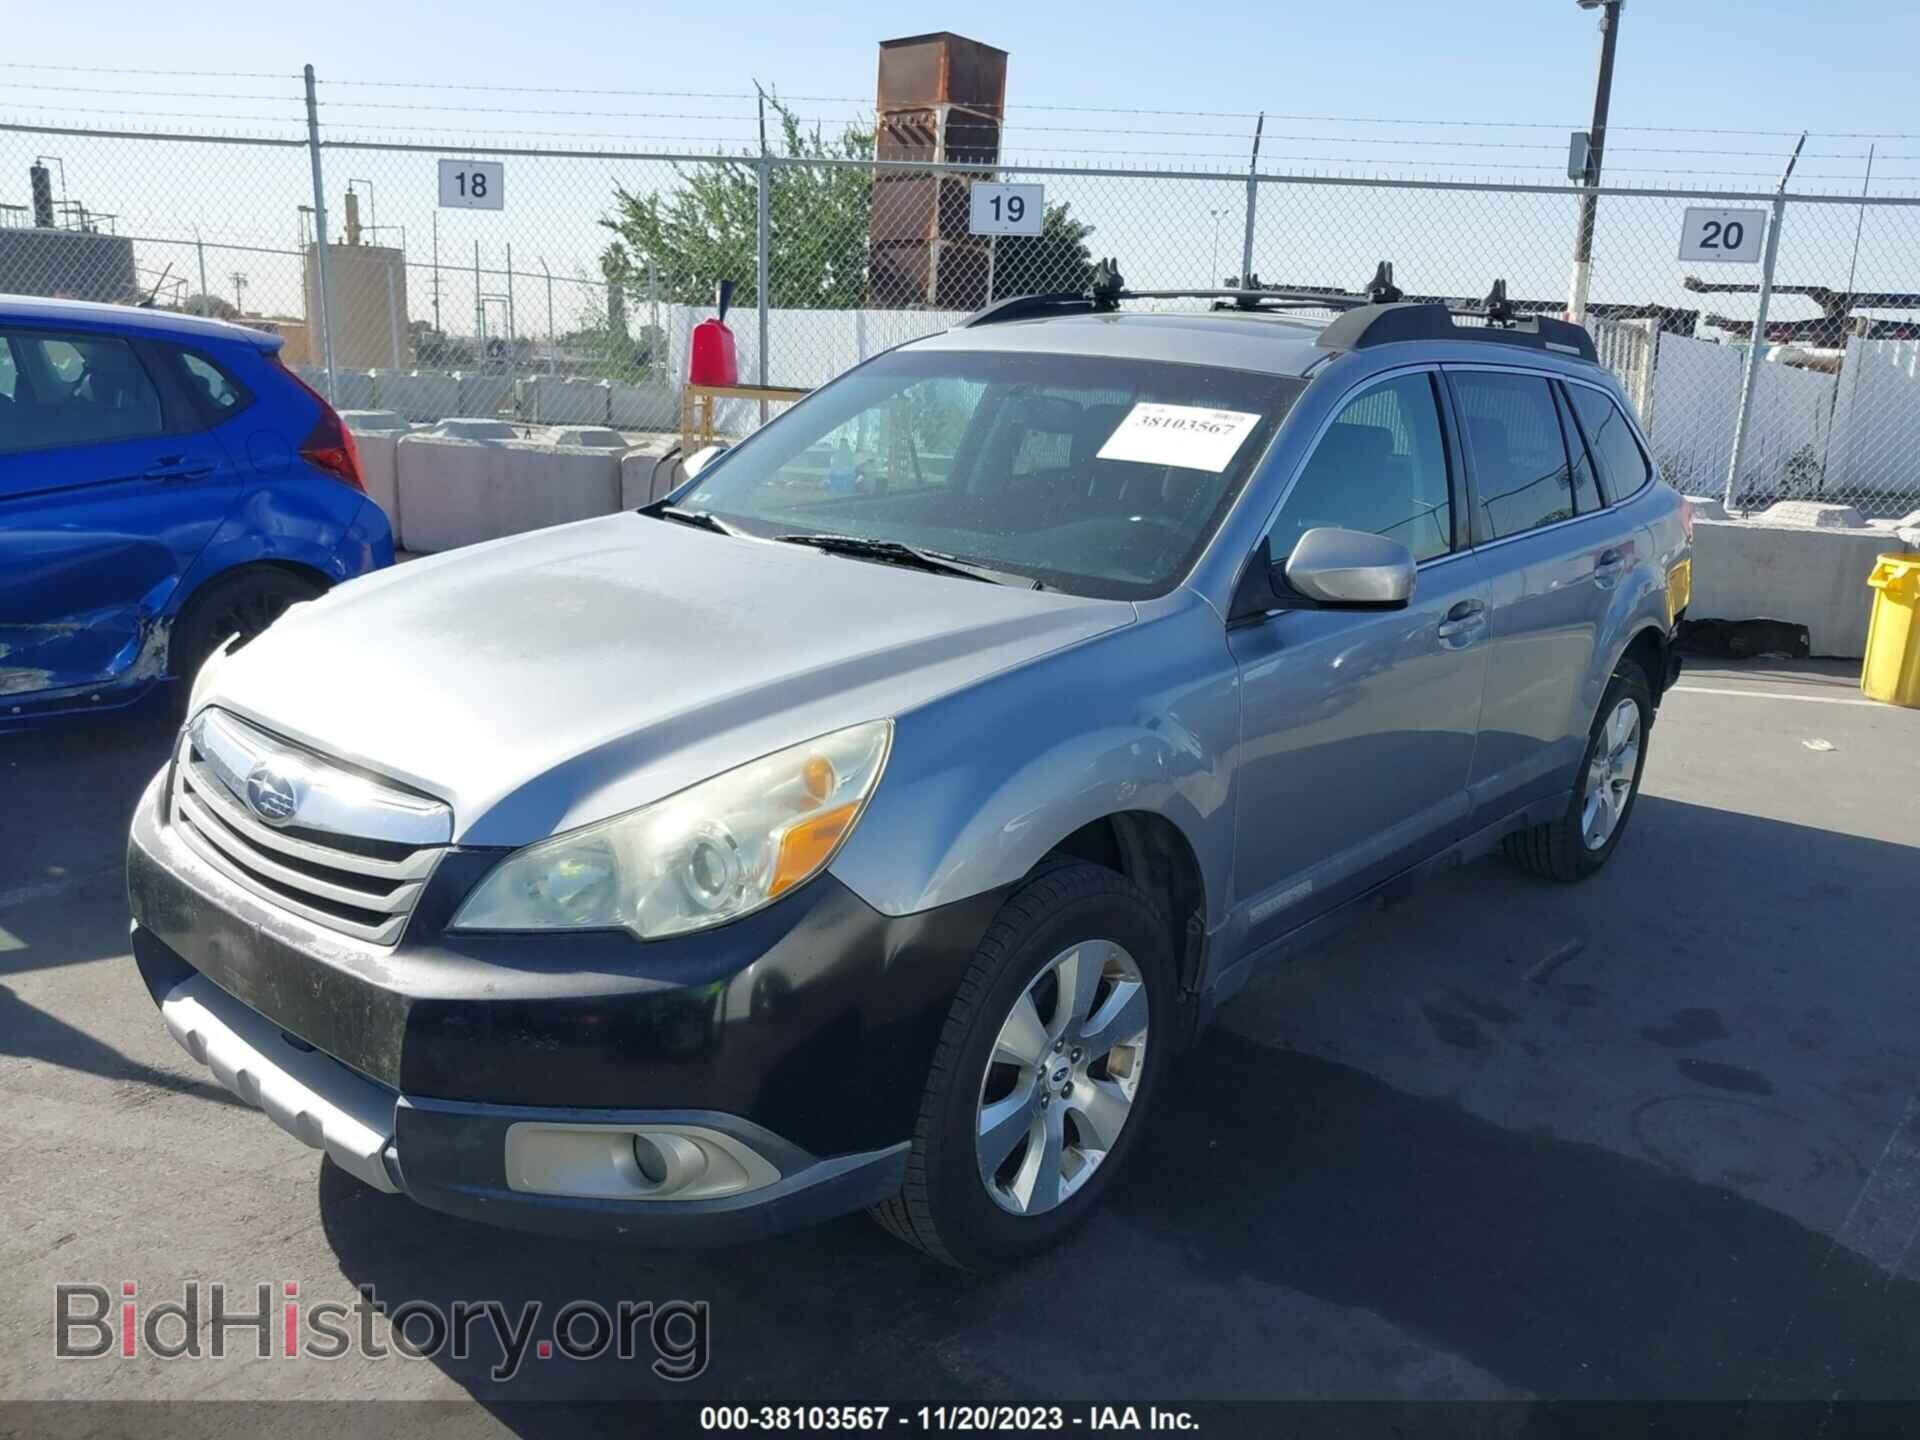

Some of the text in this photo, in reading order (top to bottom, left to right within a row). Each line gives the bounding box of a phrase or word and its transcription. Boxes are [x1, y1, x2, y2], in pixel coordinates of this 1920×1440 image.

[455, 171, 487, 198] 18
[989, 195, 1025, 222] 19
[1699, 221, 1744, 250] 20
[1135, 415, 1237, 435] 38103567
